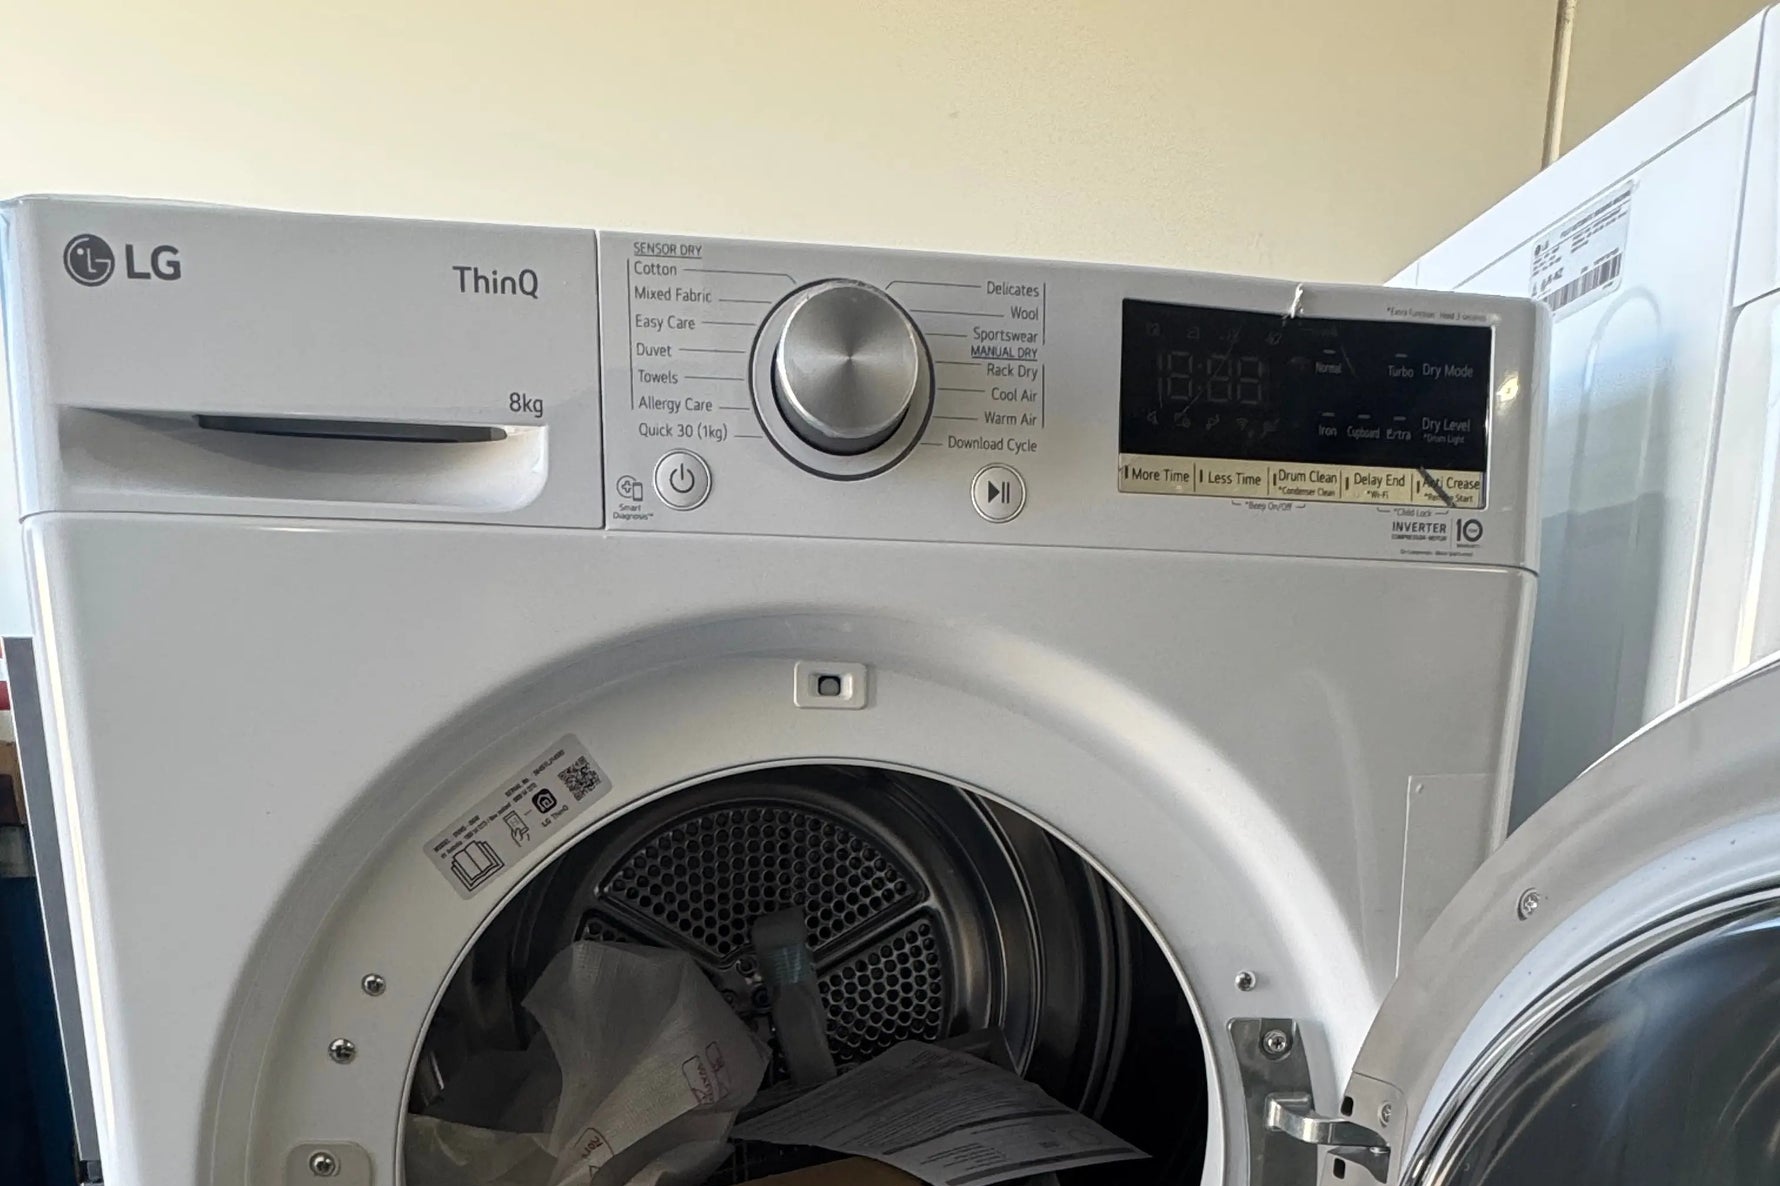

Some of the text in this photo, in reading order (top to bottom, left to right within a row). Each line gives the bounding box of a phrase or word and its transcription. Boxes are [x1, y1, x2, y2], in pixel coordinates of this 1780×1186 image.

[634, 242, 702, 256] SENSOR DRY
[126, 244, 181, 281] LG
[634, 261, 677, 276] Cotton
[451, 266, 539, 298] ThinQ
[986, 281, 1039, 297] Delicates
[634, 286, 712, 303] Mixed Fabric
[1010, 307, 1039, 321] Wool
[635, 314, 696, 331] Easy Care
[973, 326, 1038, 344] Sportswear
[636, 343, 671, 357] Duvet
[971, 345, 1038, 359] MANUAL DRY
[987, 363, 1038, 381] Rack Dry
[1315, 362, 1342, 374] Normal
[1388, 365, 1414, 378] Turbo
[1422, 363, 1474, 379] Dry Mode
[638, 370, 678, 384] Towels
[991, 387, 1038, 402] Cool Air
[509, 393, 544, 417] 8kg
[639, 395, 712, 413] Allergy Care
[984, 412, 1037, 427] Warm Air
[1422, 417, 1471, 433] Dry Level
[639, 423, 728, 441] Quick 30 (1kg)
[1319, 425, 1337, 436] Iron
[948, 436, 1038, 454] Download Cycle
[1132, 468, 1190, 482] More Time
[1208, 472, 1261, 486] Less Time
[1279, 470, 1337, 484] Drum Clean
[1354, 473, 1405, 488] Delay End
[1447, 478, 1480, 490] Crease
[619, 504, 641, 512] Smart
[1392, 522, 1446, 534] INVERTER
[1456, 519, 1483, 542] 10
